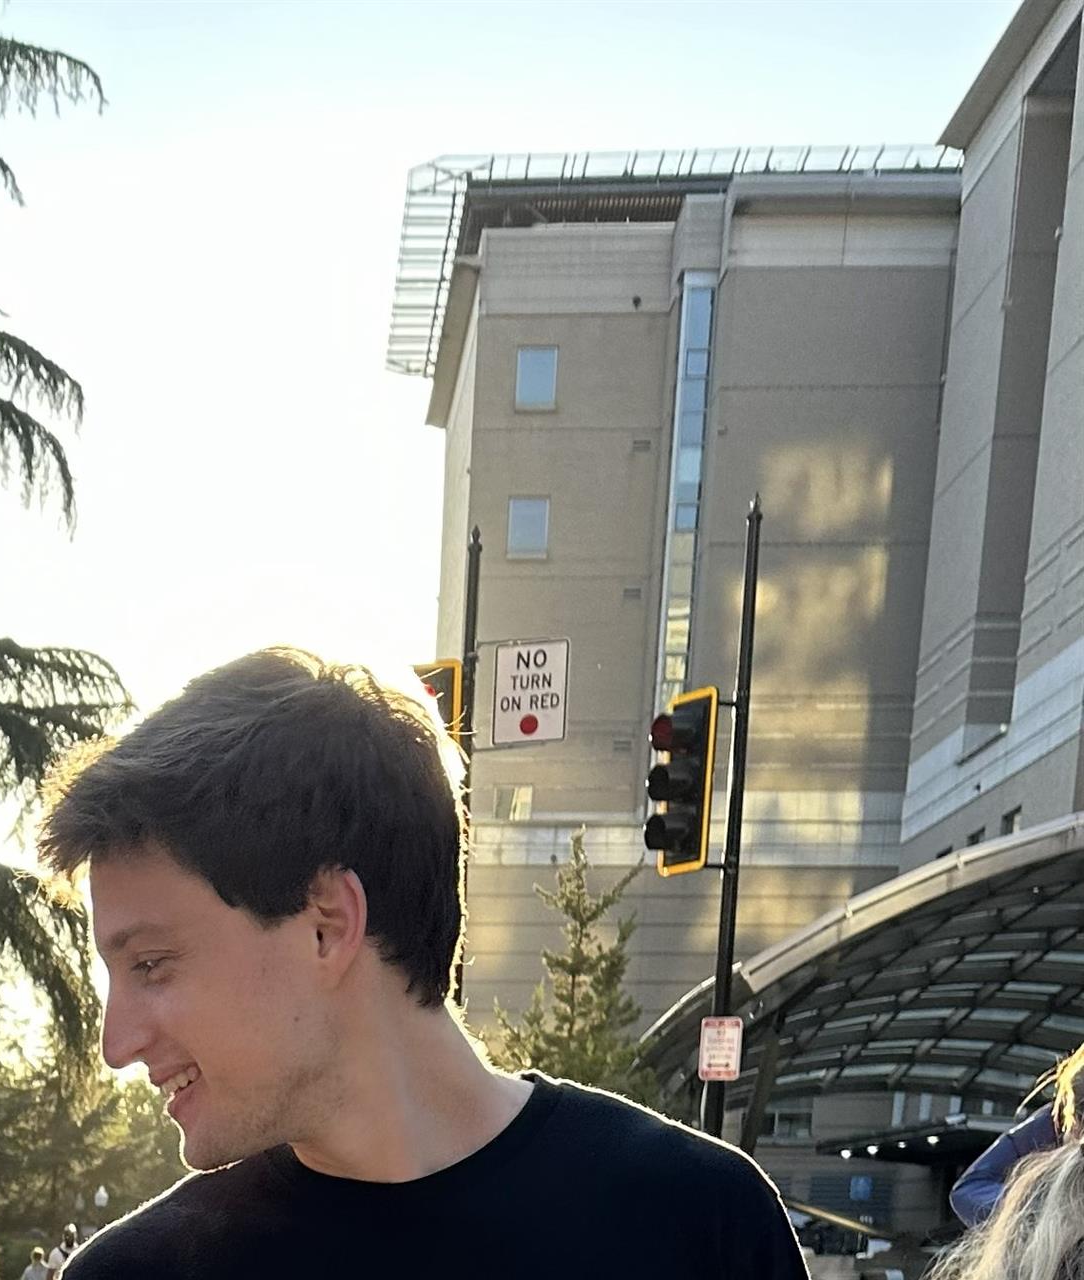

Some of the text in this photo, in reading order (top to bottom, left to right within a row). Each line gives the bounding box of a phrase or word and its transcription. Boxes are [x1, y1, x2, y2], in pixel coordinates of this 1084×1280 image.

[516, 649, 547, 670] NO
[511, 672, 552, 691] TURN
[500, 693, 560, 712] ON RED
